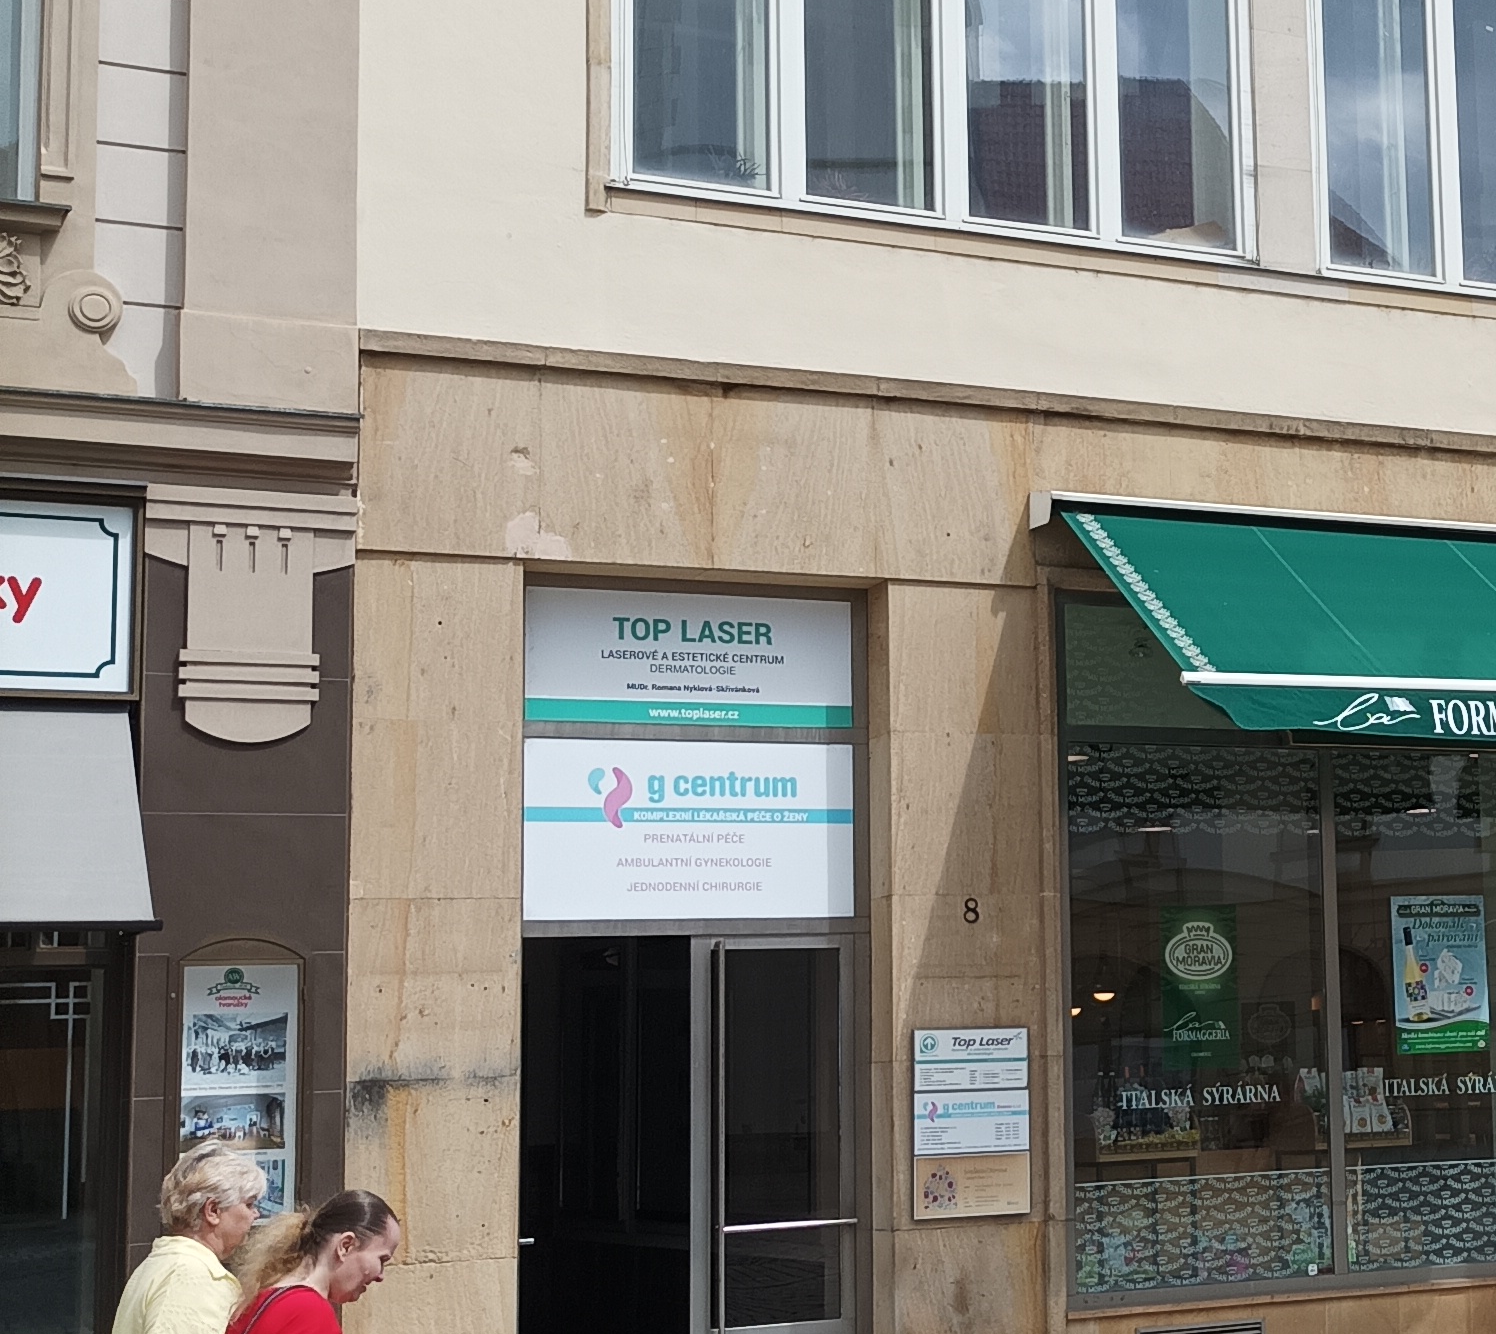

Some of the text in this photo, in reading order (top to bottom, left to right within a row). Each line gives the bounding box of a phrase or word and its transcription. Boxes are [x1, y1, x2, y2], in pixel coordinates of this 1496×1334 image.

[0, 575, 43, 624] y
[612, 616, 773, 646] TOP LASER
[601, 649, 785, 665] LASEROVÉ A ESTETICKÉ CENTRUM
[650, 663, 736, 676] DERMATOLOGIE
[651, 684, 682, 692] Romana
[648, 708, 740, 720] www.toplaser.cz
[648, 771, 798, 803] g centrum
[633, 810, 809, 823] KOMPLEXNÍ LÉKAŘSKÁ PÉČE O ŽENY
[644, 832, 745, 844] PRENATÁLNÍ PÉČE
[617, 856, 772, 868] AMBULANTNÍ GYNEKOLOGIE
[627, 880, 763, 892] JEDNODENNÍ CHIRURGIE
[963, 898, 980, 924] 8
[1411, 905, 1431, 914] GRAN
[1184, 943, 1214, 955] GRAN
[1175, 955, 1223, 967] MORAVIA
[1173, 1030, 1231, 1042] FORMAGGERIA
[952, 1036, 1014, 1049] Top Laser
[1384, 1073, 1450, 1097] ITALSKÁ
[1121, 1081, 1281, 1110] ITALSKÁ SÝRÁRNA
[951, 1100, 996, 1111] centrum
